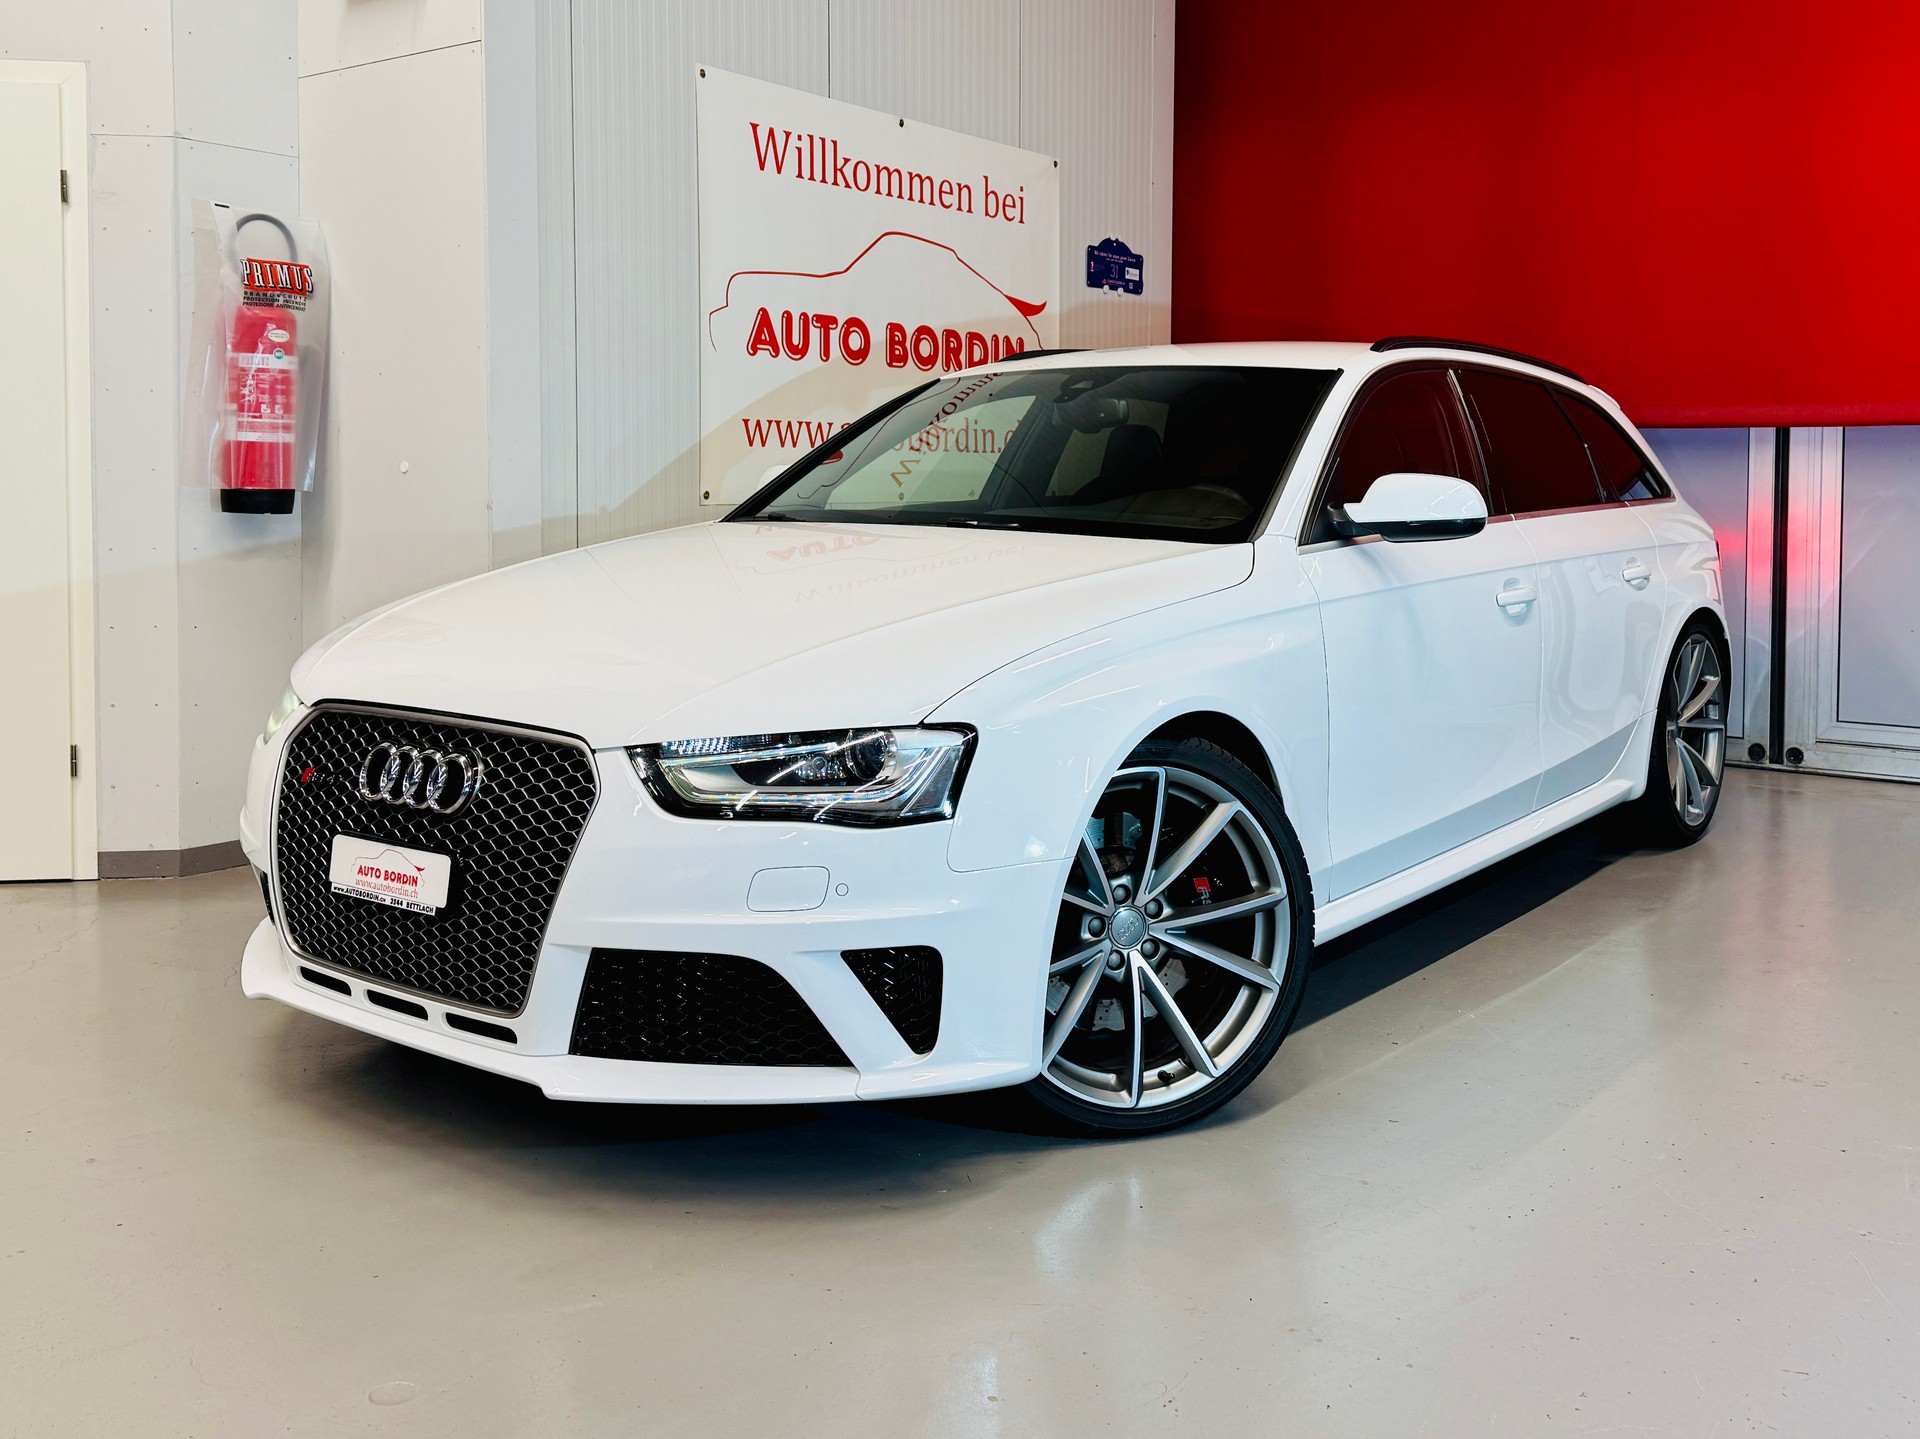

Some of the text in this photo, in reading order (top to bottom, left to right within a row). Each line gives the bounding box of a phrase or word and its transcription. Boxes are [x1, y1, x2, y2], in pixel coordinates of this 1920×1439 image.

[749, 121, 1025, 224] Willkommen bei
[241, 260, 314, 293] PRIMUS
[282, 299, 306, 307] INCENDIE
[746, 307, 871, 366] AUTO
[357, 865, 418, 887] AUTO BORDIN
[355, 878, 418, 898] www.autobordin.ch
[406, 902, 434, 913] BETTLACH
